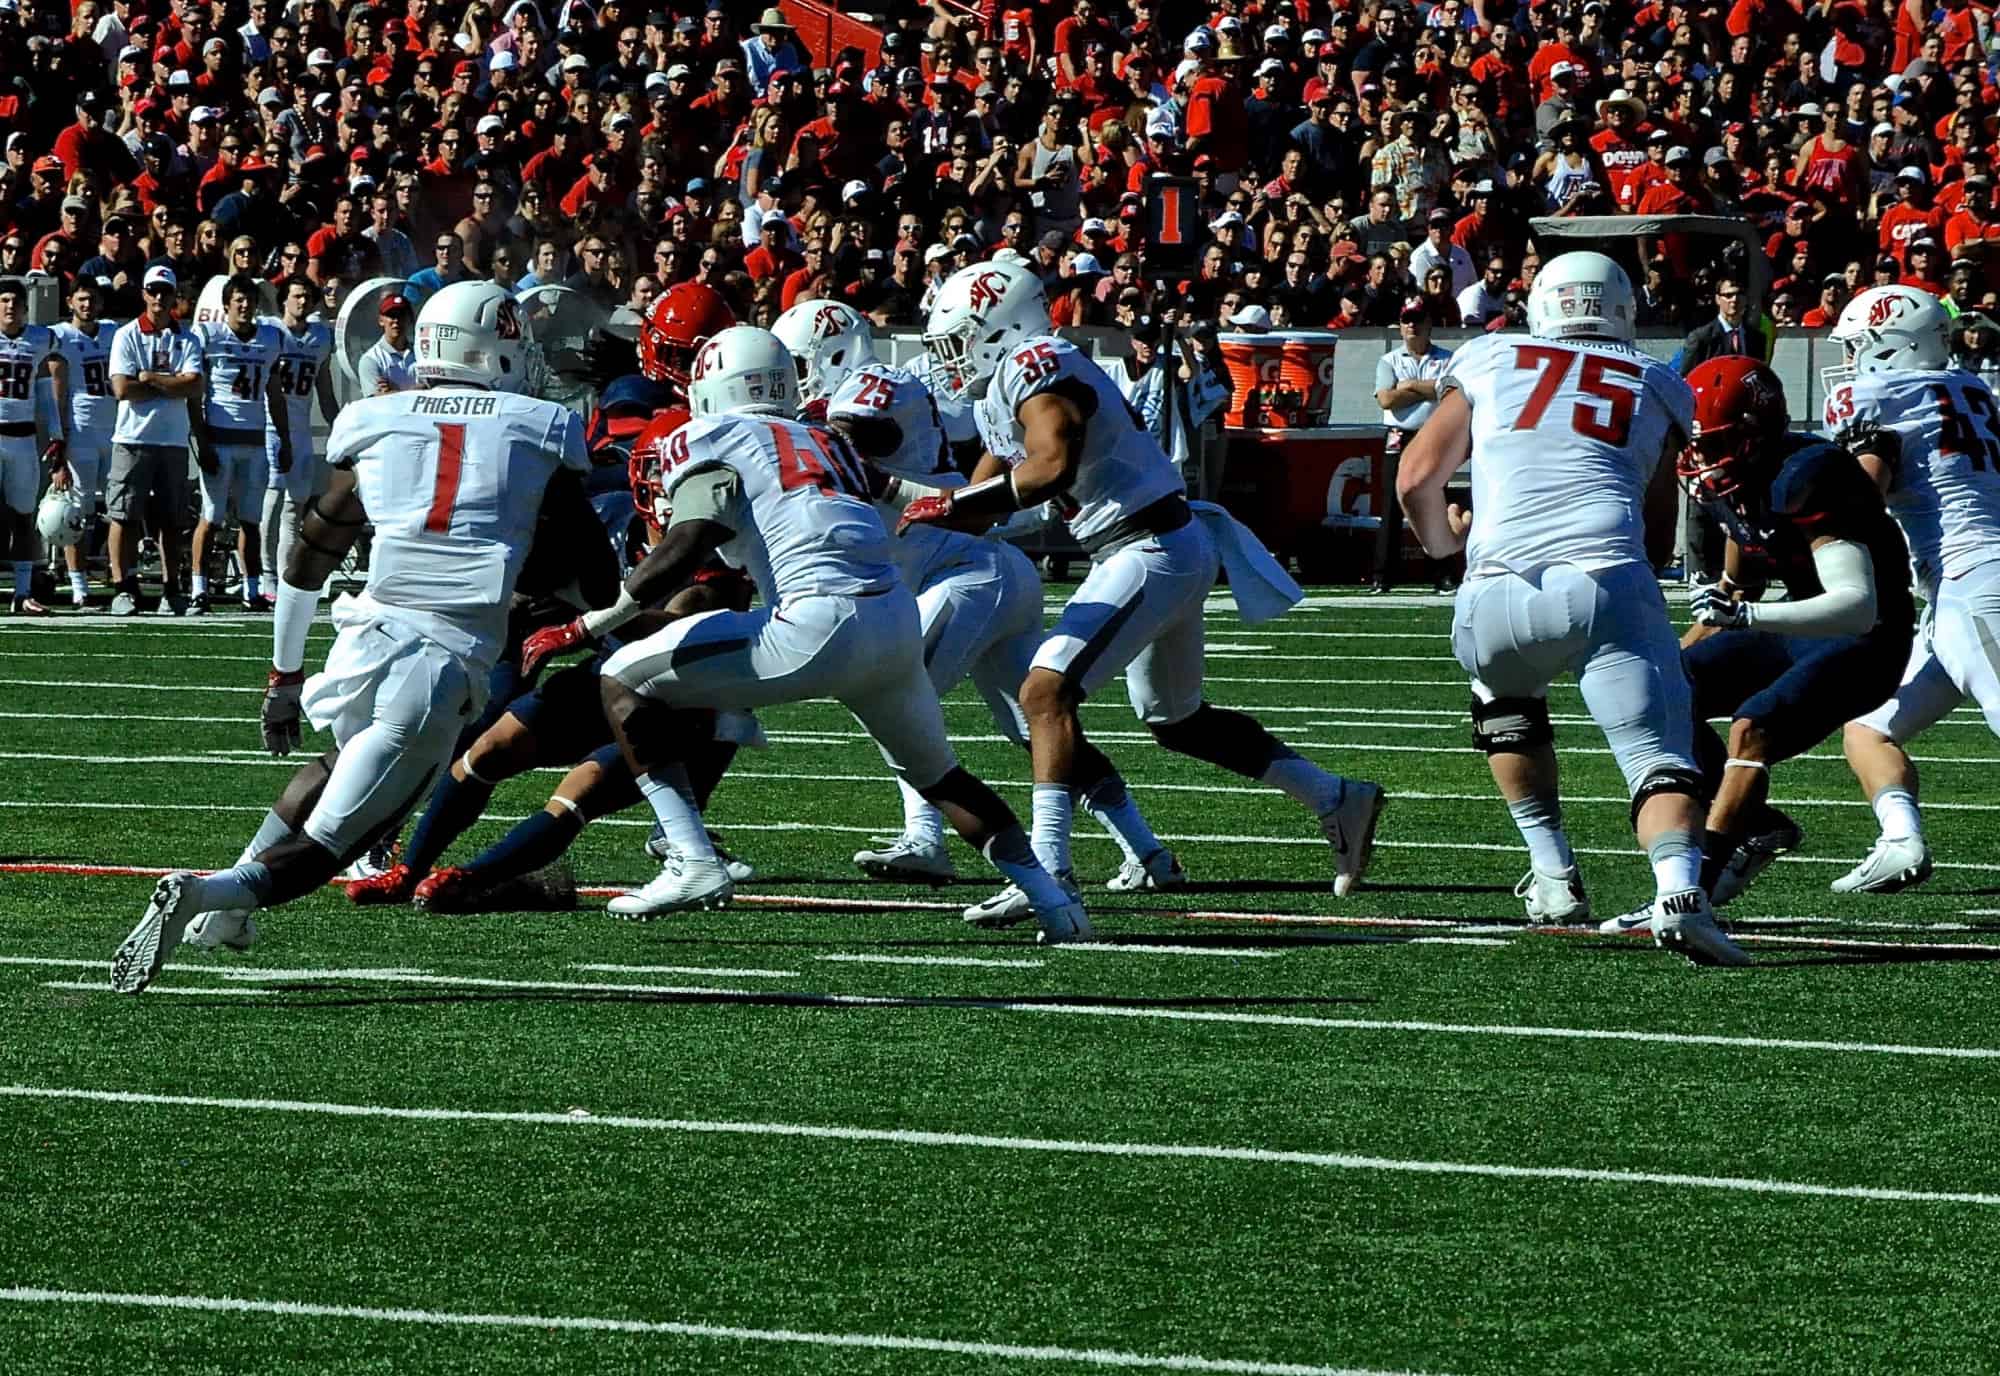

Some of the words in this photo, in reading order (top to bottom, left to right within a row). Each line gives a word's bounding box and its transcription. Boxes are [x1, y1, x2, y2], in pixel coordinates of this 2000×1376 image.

[1159, 187, 1182, 244] 1
[1582, 298, 1601, 316] 75
[1013, 342, 1061, 385] 35
[411, 395, 497, 415] PRIESTER
[769, 384, 785, 400] 40
[853, 373, 895, 410] 25
[1510, 344, 1644, 448] 75
[1825, 386, 1855, 425] 43
[421, 421, 468, 534] 1
[1662, 892, 1702, 916] NIKE
